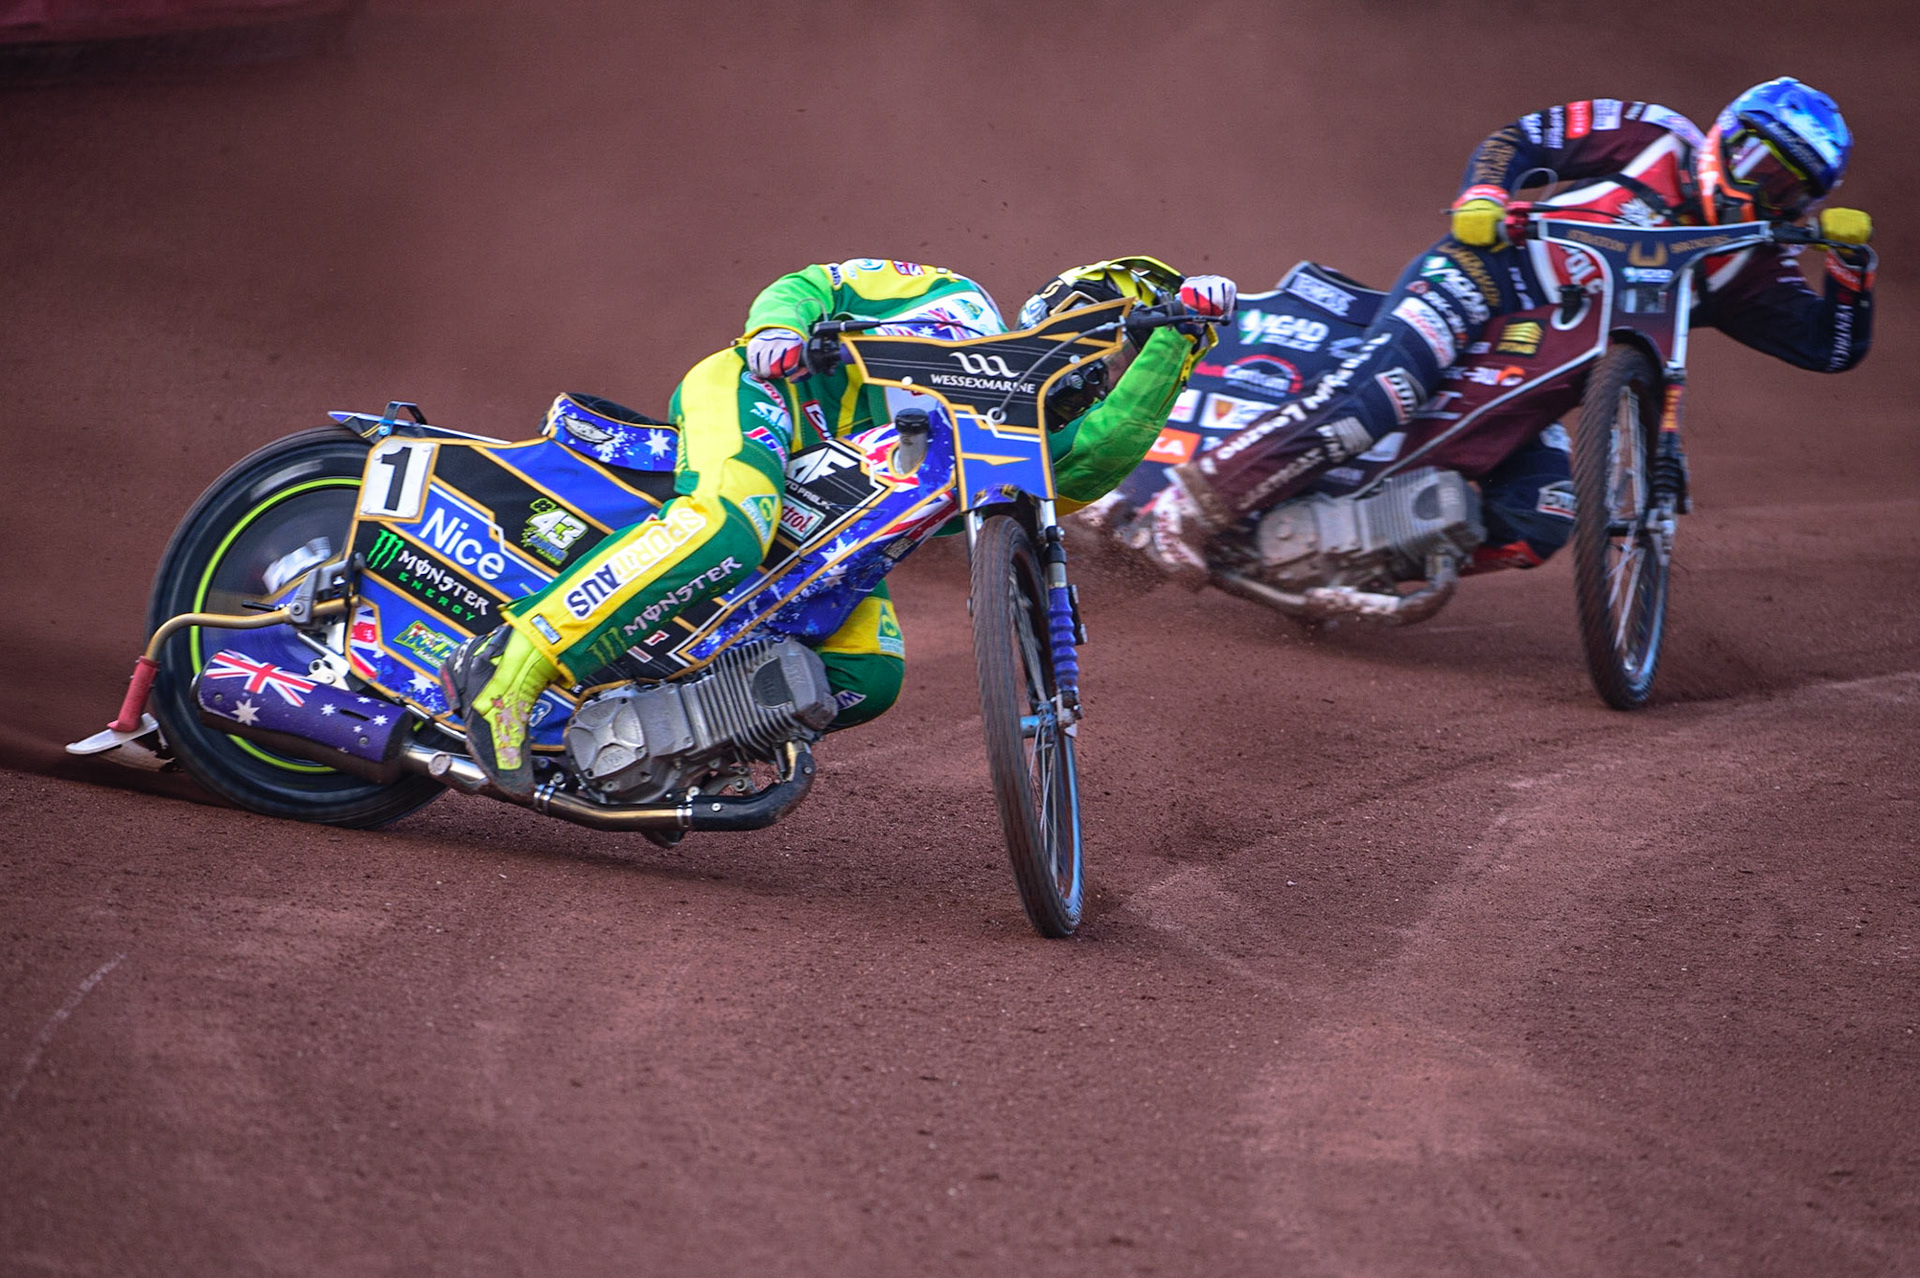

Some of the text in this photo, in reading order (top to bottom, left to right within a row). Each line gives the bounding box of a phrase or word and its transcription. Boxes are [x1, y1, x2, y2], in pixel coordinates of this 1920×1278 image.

[930, 374, 1036, 394] WESSEXMARINE
[379, 446, 412, 511] 1
[780, 504, 814, 533] trol
[419, 508, 505, 581] Nice
[398, 572, 476, 621] ENERGY
